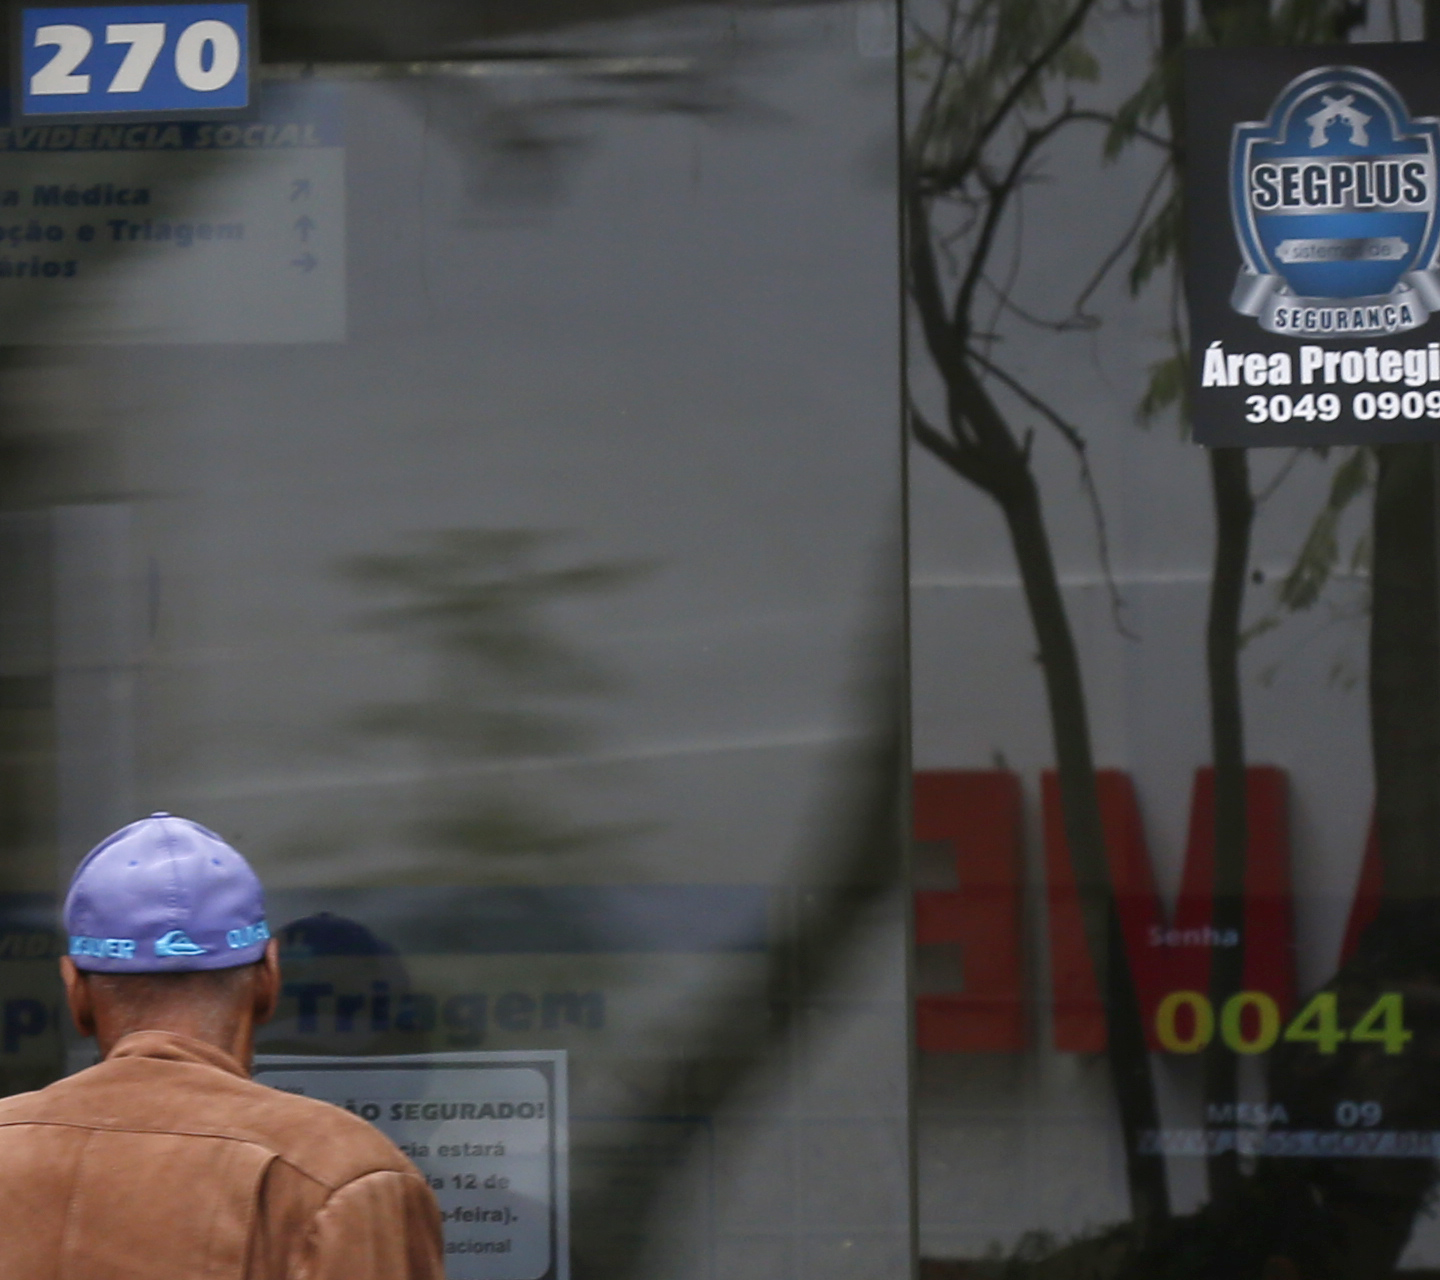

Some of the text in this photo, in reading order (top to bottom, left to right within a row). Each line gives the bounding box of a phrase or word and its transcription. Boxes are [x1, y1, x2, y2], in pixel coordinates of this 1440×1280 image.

[29, 19, 241, 97] 270
[193, 122, 322, 148] SOCIAL
[1252, 161, 1428, 208] SEGPLUS
[1275, 302, 1413, 335] SEGURANÇA
[1202, 341, 1292, 387] Área
[1246, 393, 1341, 423] 3049
[1148, 924, 1239, 948] Senha
[287, 982, 607, 1048] Triagem
[1155, 990, 1413, 1055] 0044
[390, 1101, 546, 1121] SEGURADO!
[1207, 1100, 1383, 1127] MESA 09
[436, 1140, 506, 1158] estará
[451, 1174, 478, 1190] 12
[483, 1173, 510, 1190] de
[444, 1238, 512, 1254] acional
